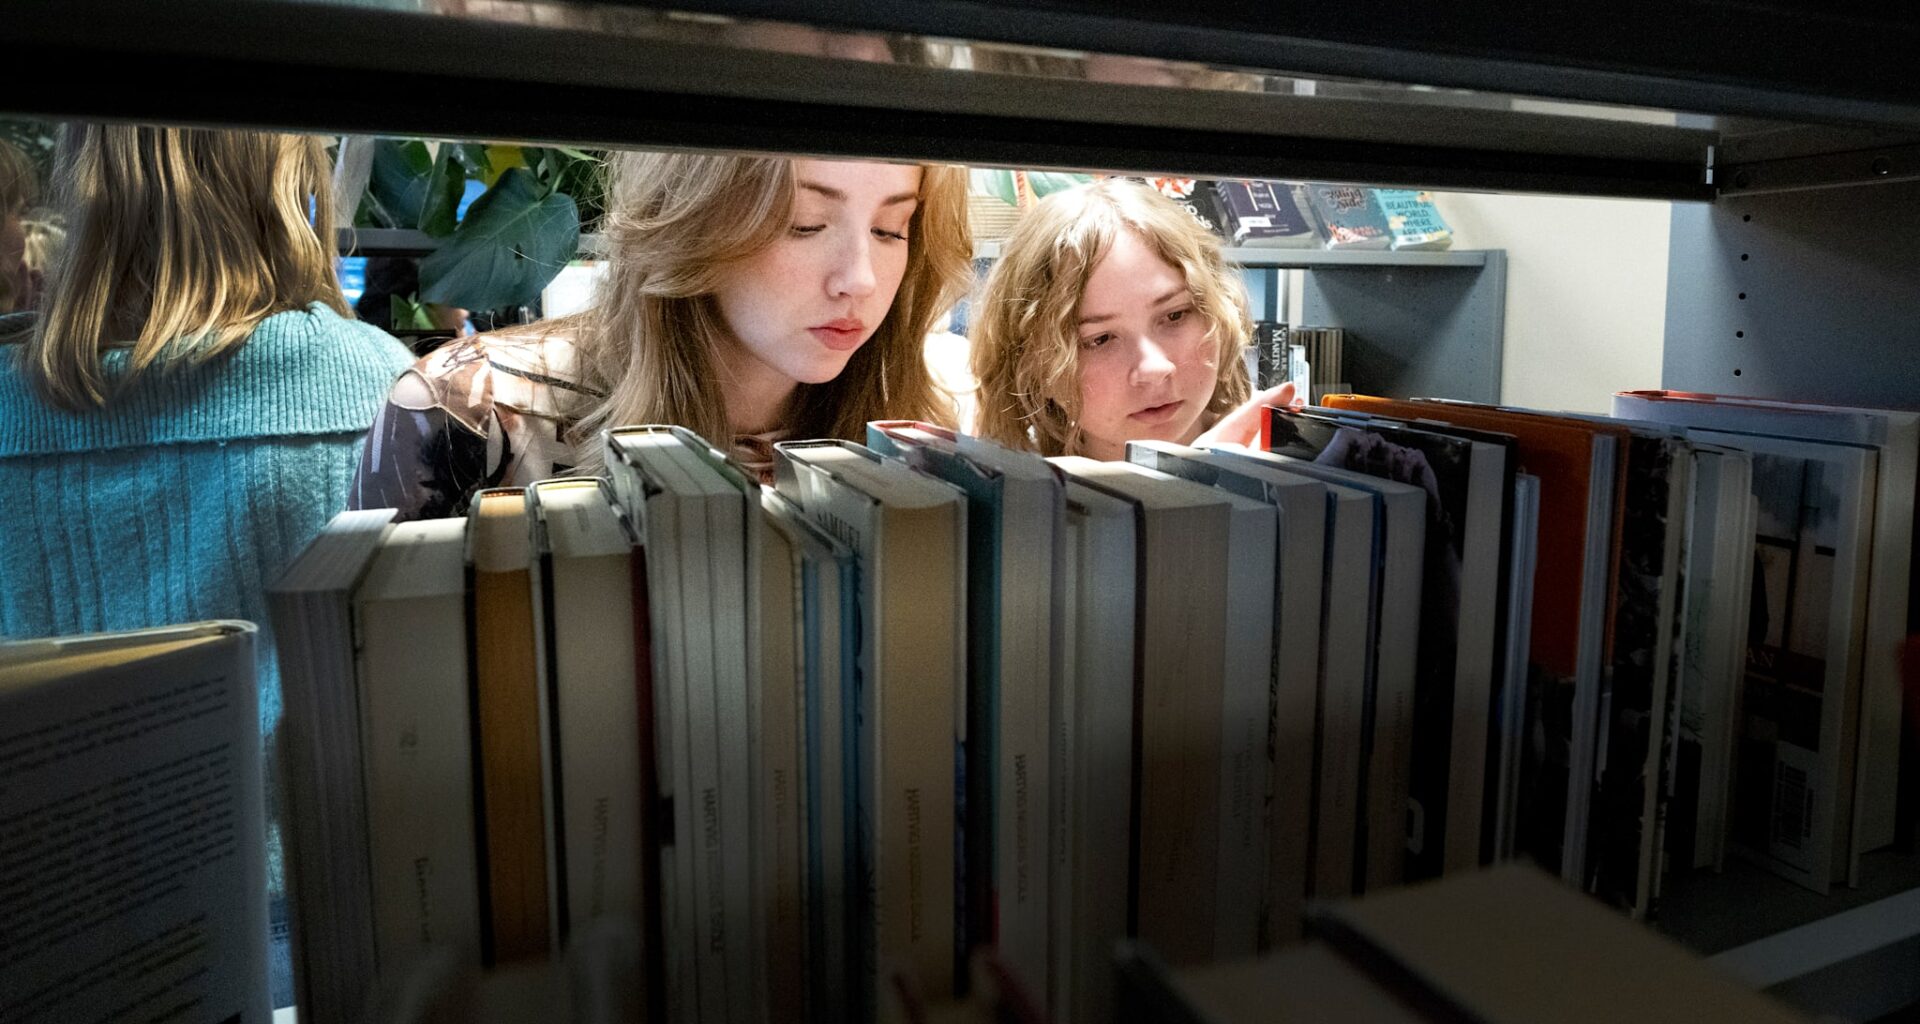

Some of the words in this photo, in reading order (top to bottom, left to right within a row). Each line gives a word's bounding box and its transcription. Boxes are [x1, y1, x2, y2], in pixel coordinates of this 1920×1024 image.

[1385, 199, 1433, 210] BEAUTIFUL
[1402, 218, 1433, 228] WHERE
[1272, 329, 1282, 371] MARTIN
[1015, 754, 1027, 808] HARTVIG
[703, 787, 718, 849] HARTVIG
[906, 788, 920, 844] HARTVIG
